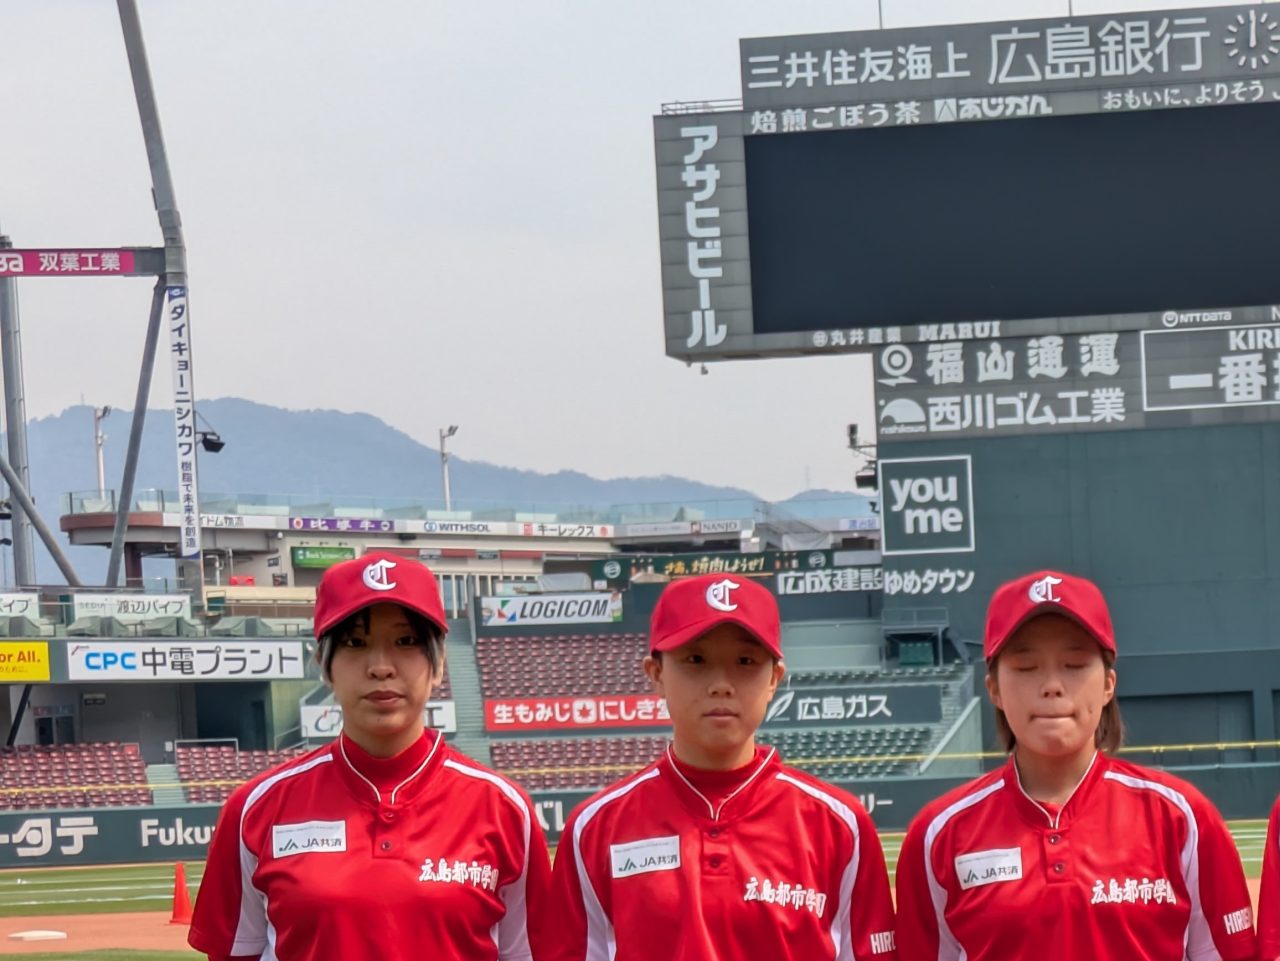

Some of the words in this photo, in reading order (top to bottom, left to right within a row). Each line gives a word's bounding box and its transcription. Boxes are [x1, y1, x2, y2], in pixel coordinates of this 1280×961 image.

[988, 17, 1210, 84] 広島銀行
[748, 44, 970, 89] 三井住友海上
[751, 101, 920, 134] 焙煎ごぼう茶
[680, 125, 728, 349] アサヒビール
[39, 252, 120, 271] 双葉工業
[918, 320, 1001, 342] MARUI
[926, 333, 1121, 386] 福山通運
[170, 302, 194, 457] ダイキョーニシカワ
[927, 387, 1126, 432] 西川ゴム工業
[890, 476, 957, 512] you
[439, 523, 491, 533] WITHSOL
[538, 524, 596, 536] キーレックス
[904, 507, 963, 535] me
[778, 567, 883, 594] 広成建設
[884, 569, 975, 595] ゆめタウン
[519, 599, 608, 619] LOGICOM
[85, 652, 137, 671] CPC
[142, 647, 299, 676] 中電プラント
[494, 704, 570, 724] 生もみじ
[797, 695, 892, 721] 広島ガス
[141, 817, 215, 847] Fuku
